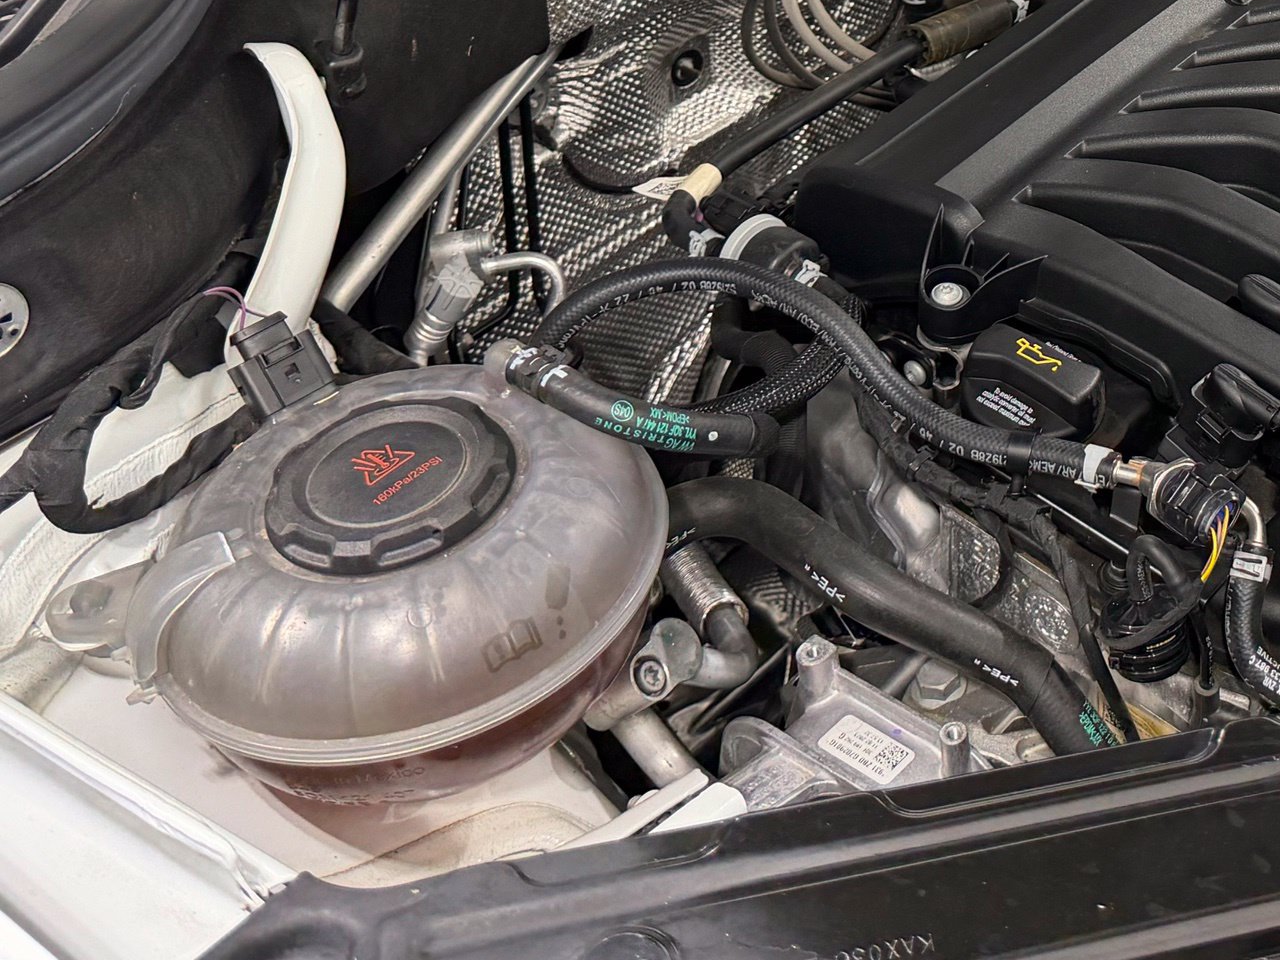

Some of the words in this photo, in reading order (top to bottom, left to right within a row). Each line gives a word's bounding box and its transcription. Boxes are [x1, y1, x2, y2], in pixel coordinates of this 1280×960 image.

[593, 417, 664, 444] TRISTONE
[372, 456, 443, 506] 160kPa/23PSI
[811, 570, 846, 603] >PE<
[982, 662, 1019, 687] >PE<
[1255, 660, 1270, 673] 987
